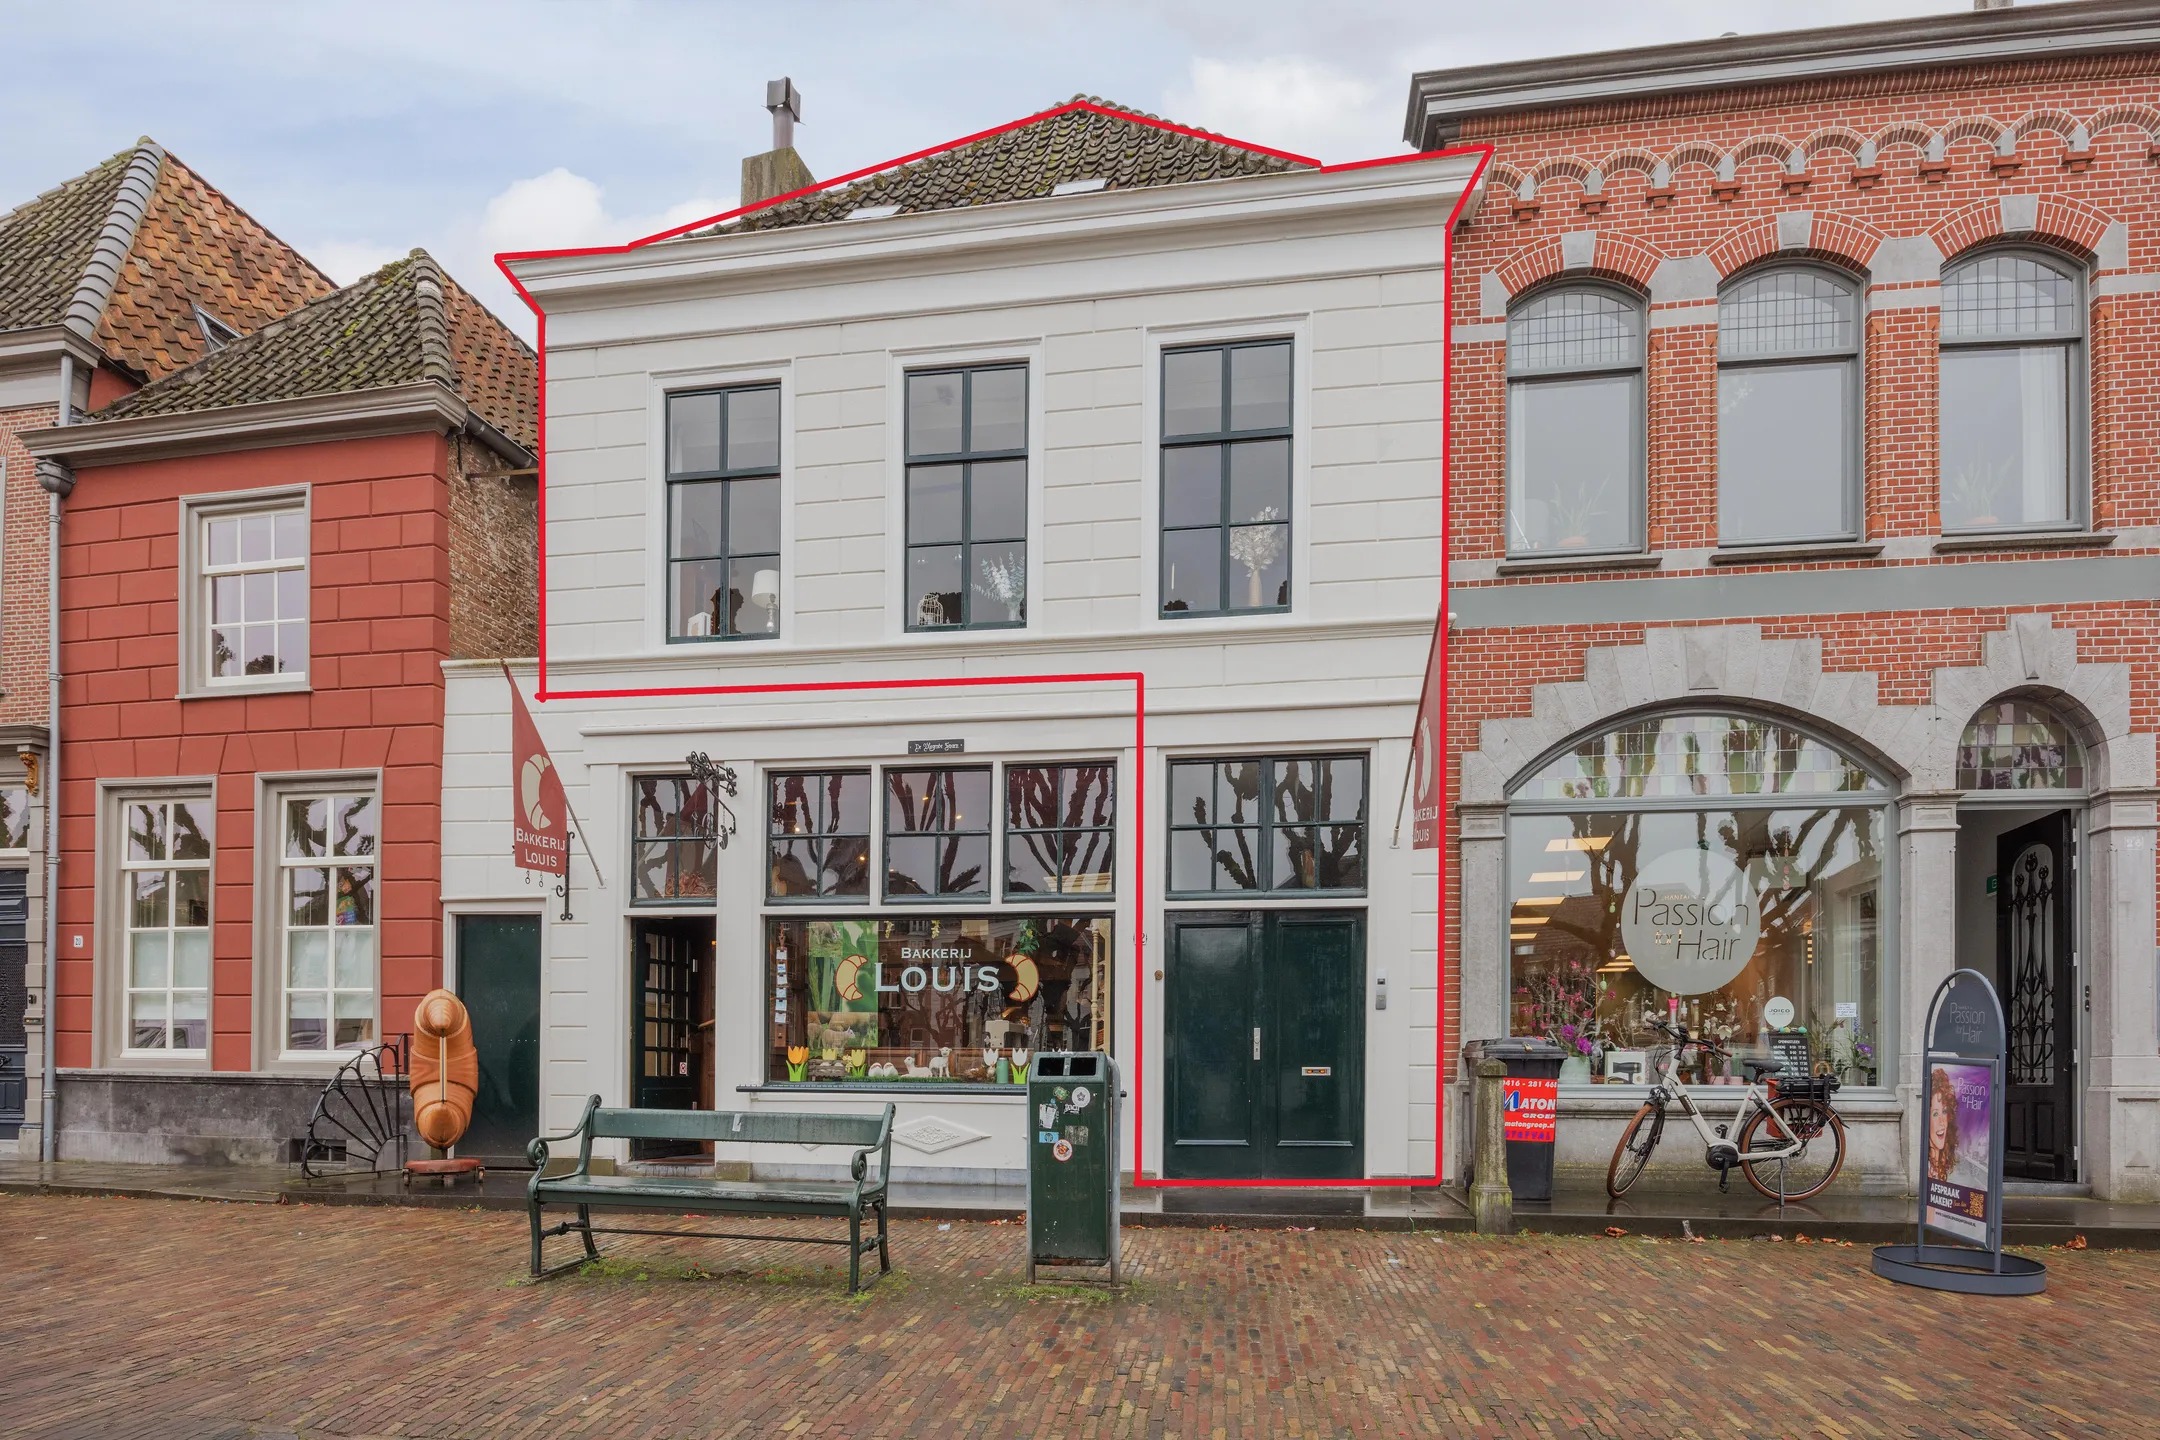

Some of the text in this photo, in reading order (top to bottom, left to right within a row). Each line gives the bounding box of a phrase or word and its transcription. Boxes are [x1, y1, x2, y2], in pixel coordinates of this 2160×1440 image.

[516, 827, 566, 851] BAKKERIJ
[525, 848, 558, 867] LOUIS
[1634, 888, 1749, 926] Passion
[901, 947, 972, 959] BAKKERIJ
[1676, 929, 1740, 961] Hair
[874, 962, 1000, 993] LOUIS
[1949, 1002, 1986, 1025] Passion
[1961, 1025, 1983, 1043] Hair
[1957, 1077, 1986, 1097] Passion
[1503, 1090, 1556, 1112] MATON
[1966, 1096, 1983, 1110] Hair
[1930, 1182, 1960, 1200] AFSPRAAK
[1930, 1193, 1953, 1208] MAKEN?
